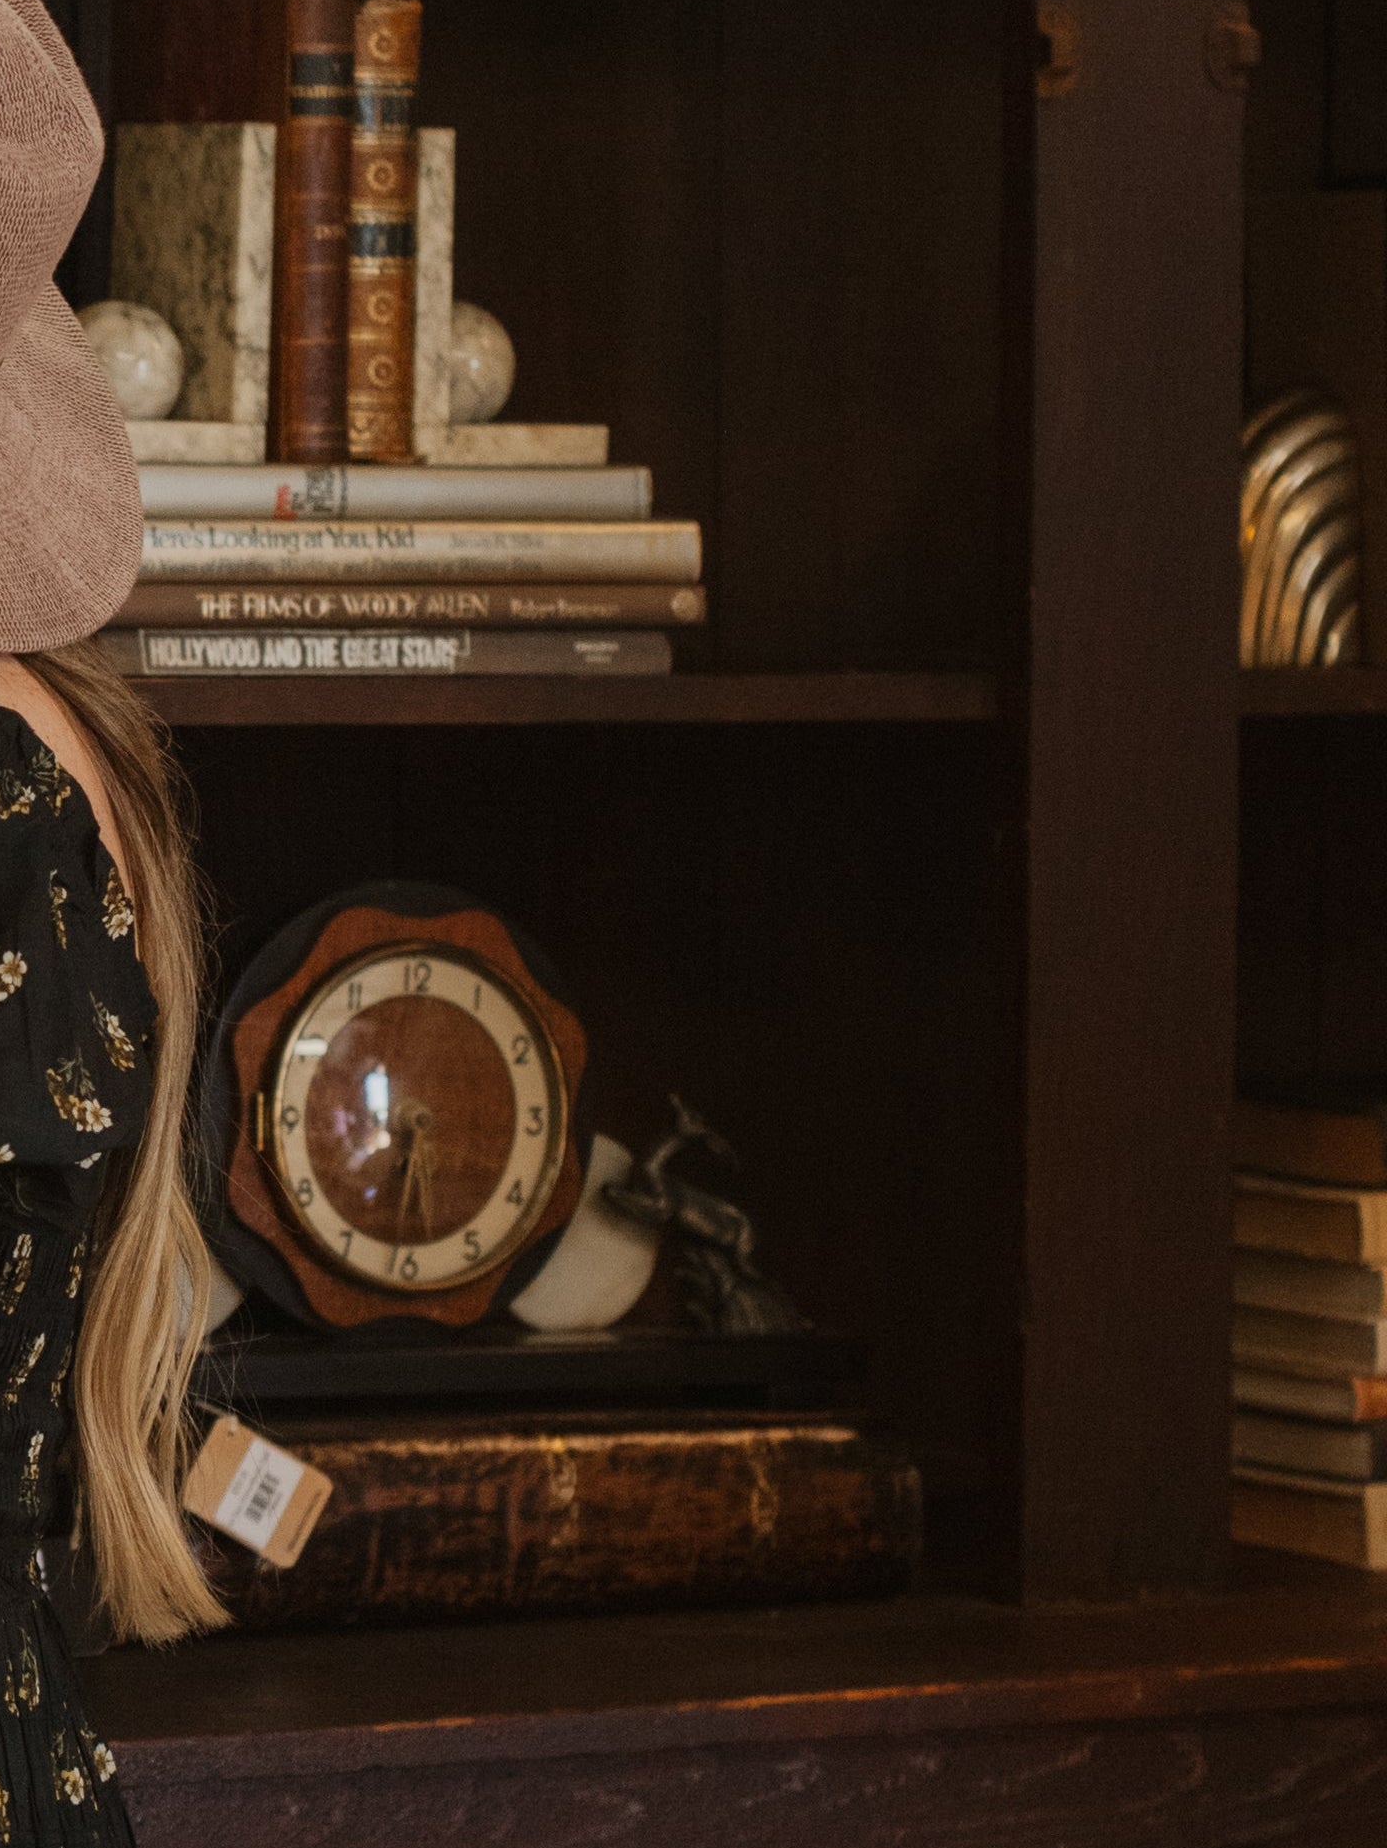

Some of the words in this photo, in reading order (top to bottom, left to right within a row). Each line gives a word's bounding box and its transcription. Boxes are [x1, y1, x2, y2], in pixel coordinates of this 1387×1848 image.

[209, 525, 301, 554] Looking
[376, 524, 416, 550] Kid
[196, 592, 238, 619] THE
[241, 592, 301, 619] FILMS
[341, 593, 420, 619] WOODY
[426, 593, 490, 619] ALLEN
[147, 635, 260, 668] HOLLYWOOD
[262, 636, 302, 668] AND
[303, 636, 339, 668] THE
[340, 636, 399, 669] GREAT
[401, 636, 458, 671] STARS
[404, 964, 433, 994] 12
[511, 1035, 532, 1065] 2
[282, 1106, 300, 1134] 9
[526, 1106, 544, 1136] 3
[504, 1183, 526, 1208] 4
[463, 1231, 483, 1262] 5
